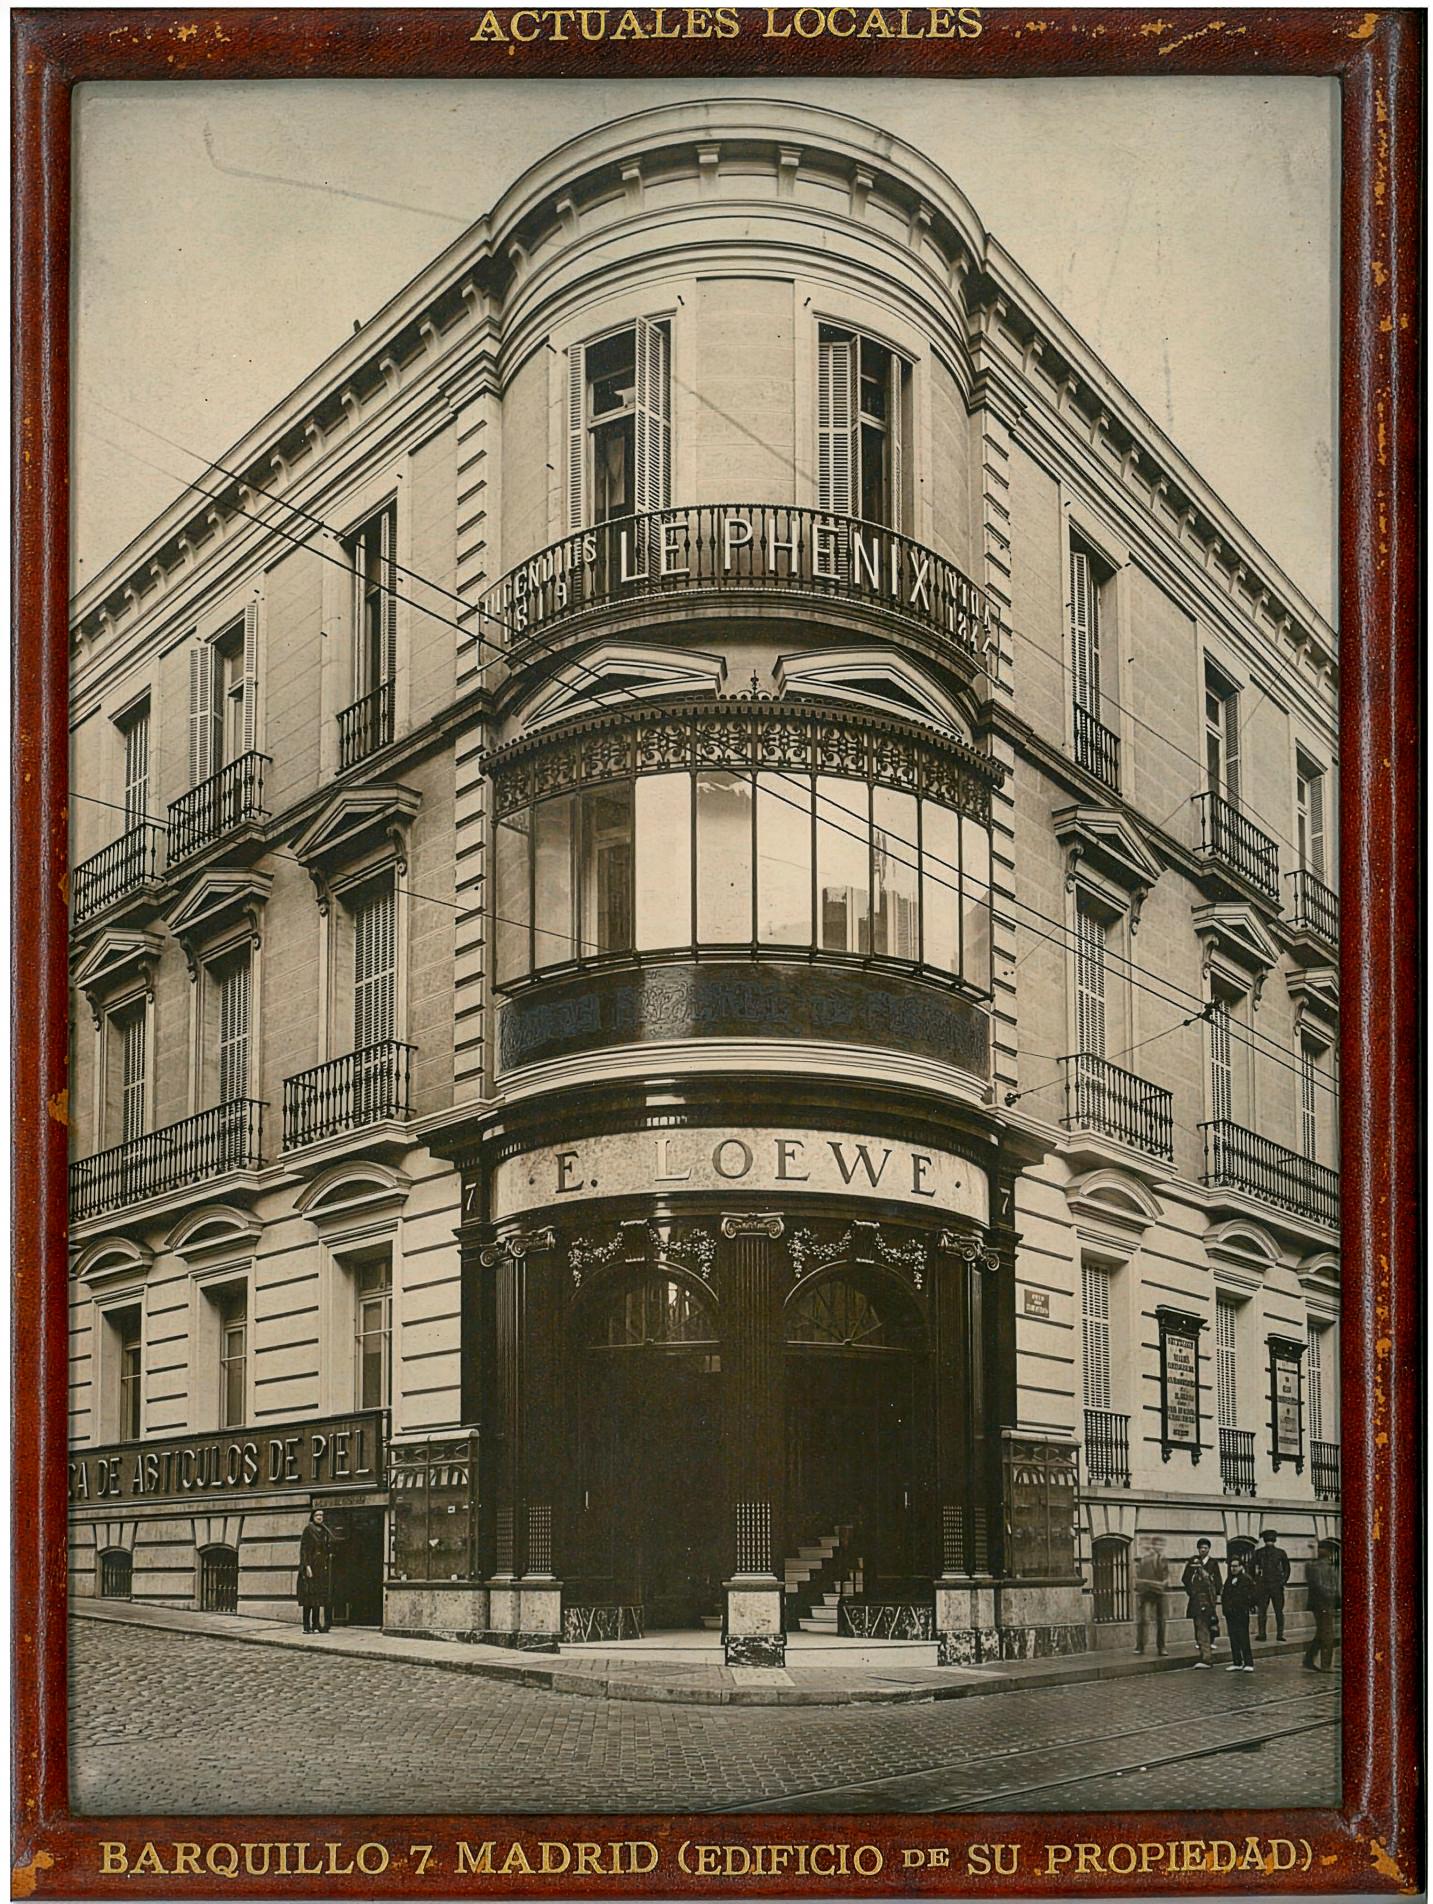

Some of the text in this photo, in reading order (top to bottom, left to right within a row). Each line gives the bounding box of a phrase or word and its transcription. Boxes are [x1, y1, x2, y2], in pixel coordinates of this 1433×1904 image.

[470, 7, 983, 42] ACTUALES LOCALES
[620, 520, 690, 582] LE
[654, 1138, 937, 1197] LOEWE
[465, 1182, 477, 1211] 7
[999, 1186, 1011, 1215] 7
[96, 1456, 121, 1496] DE
[268, 1437, 301, 1482] DE
[311, 1429, 371, 1480] PIEL
[99, 1838, 1314, 1878] BARQUILLO 7 MADRID (EDIFICIO DE SU PROPIEDAD)
